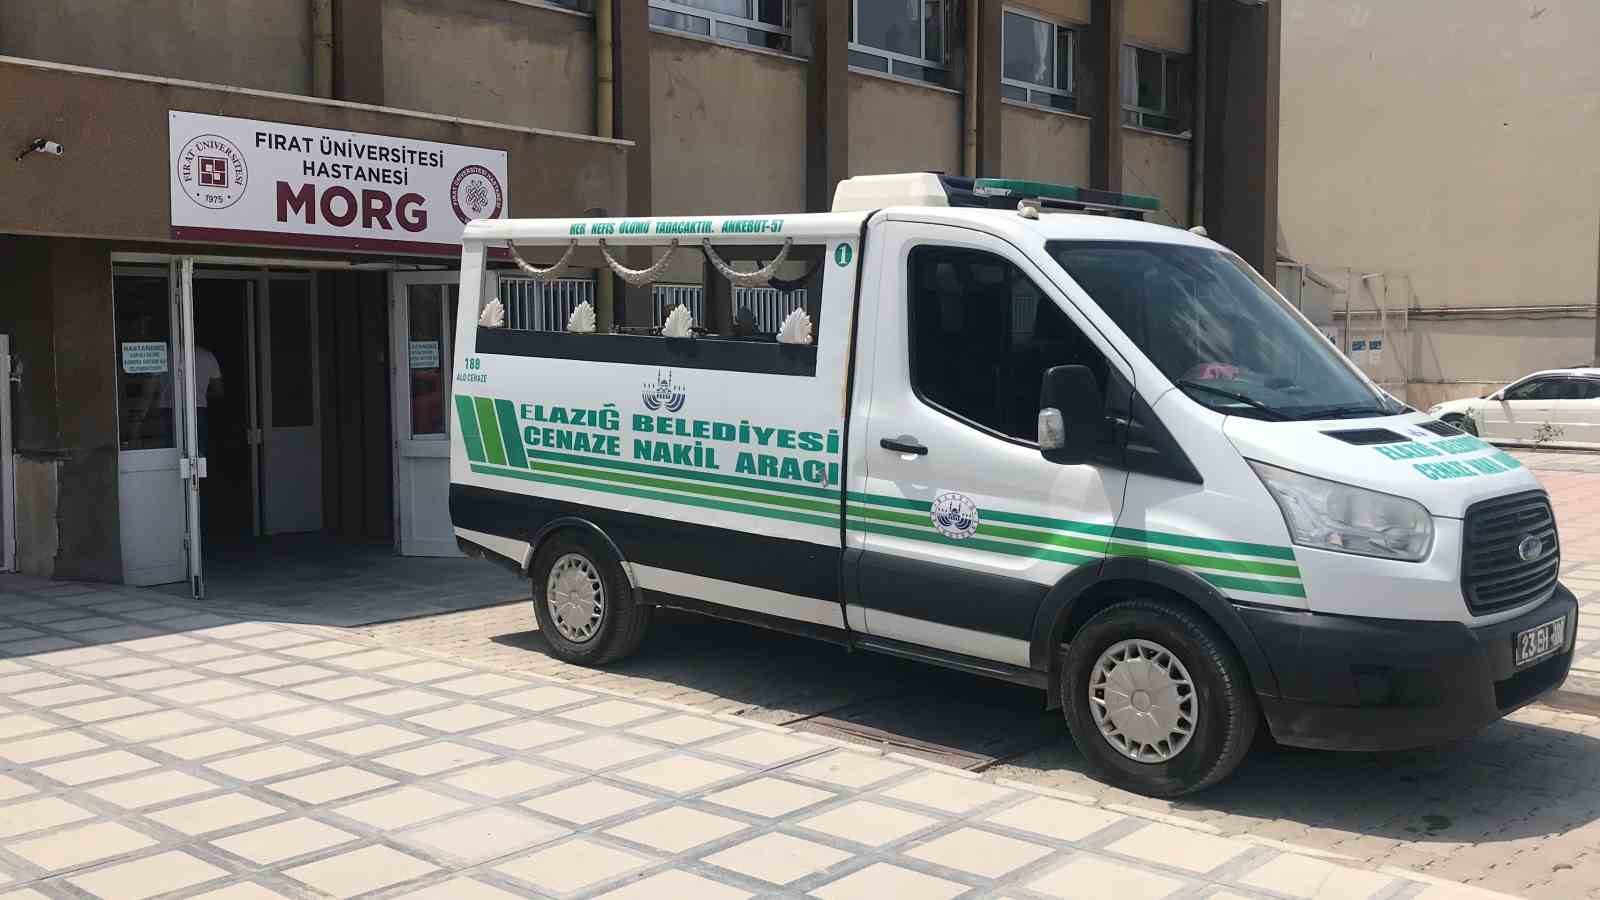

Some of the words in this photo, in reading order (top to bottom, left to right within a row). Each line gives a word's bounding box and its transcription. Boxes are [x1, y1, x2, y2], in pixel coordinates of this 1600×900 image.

[182, 149, 196, 182] FIRAT
[255, 132, 314, 153] FIRAT
[320, 136, 444, 168] ÜNİVERSİTESİ
[303, 160, 409, 186] HASTANESİ
[206, 194, 224, 204] 1975
[276, 180, 429, 233] MORG
[464, 357, 481, 370] 188
[520, 403, 620, 431] ELAZIĞ
[632, 414, 840, 455] BELEDİYESİ
[524, 425, 621, 457] CENAZE
[633, 440, 720, 470] NAKİL
[735, 451, 839, 486] ARACI
[1521, 632, 1537, 659] 23
